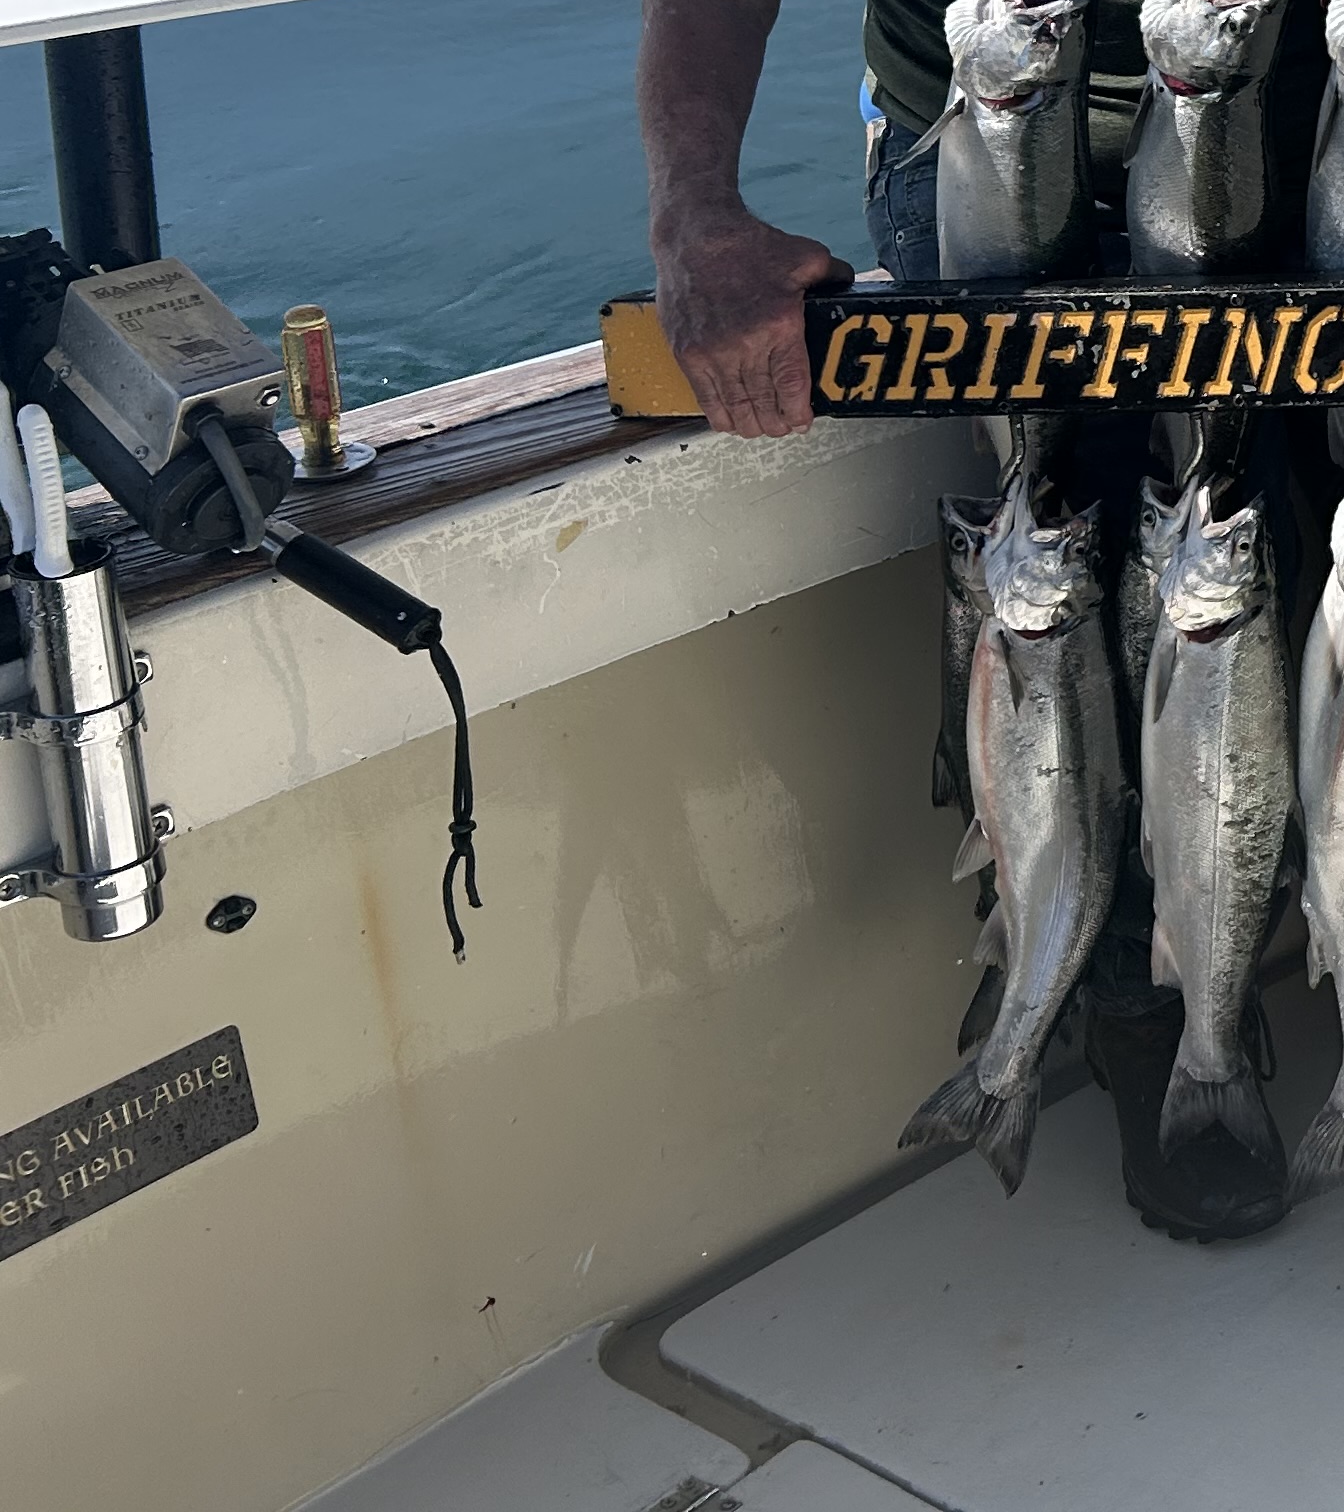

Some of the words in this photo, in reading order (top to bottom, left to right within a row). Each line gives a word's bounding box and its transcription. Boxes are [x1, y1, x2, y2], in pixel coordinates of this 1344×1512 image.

[90, 271, 185, 299] MAGNUM
[115, 294, 202, 321] TITANIUM
[50, 1053, 235, 1161] AVAILABLE
